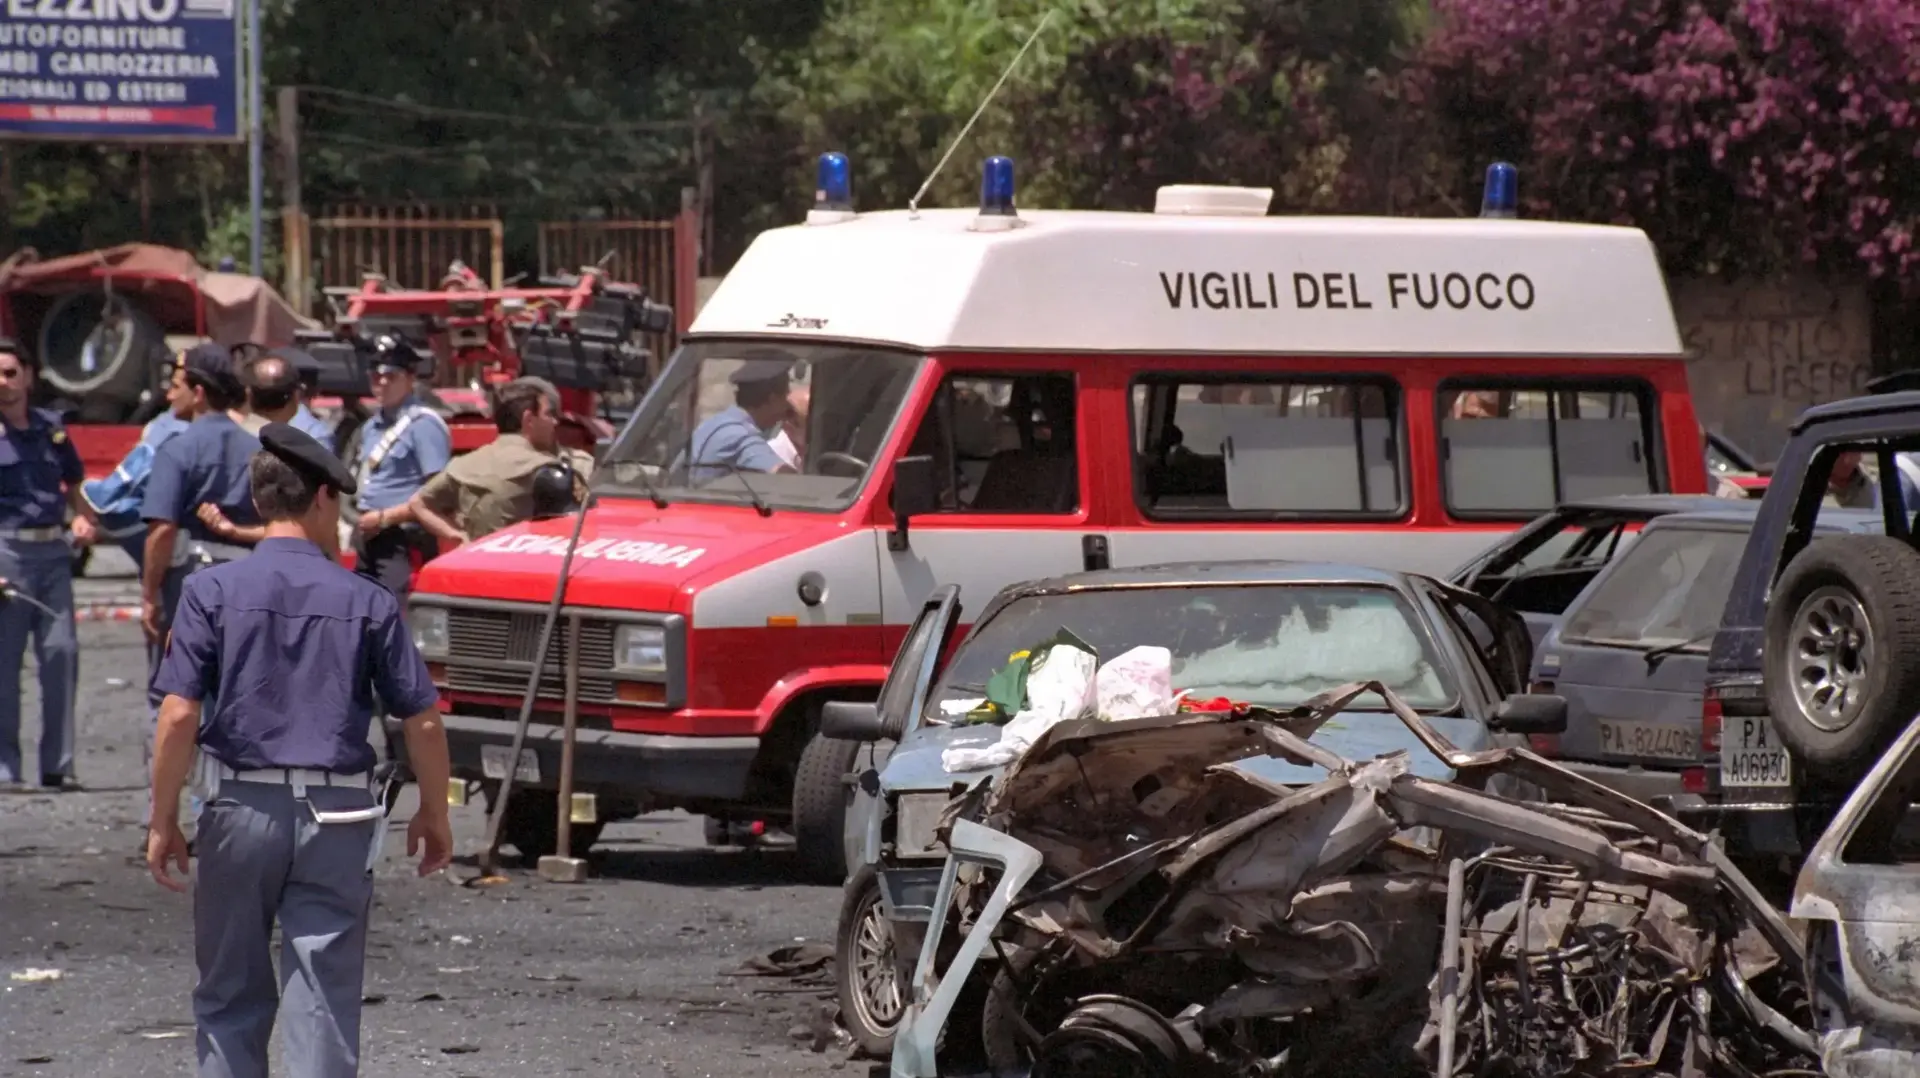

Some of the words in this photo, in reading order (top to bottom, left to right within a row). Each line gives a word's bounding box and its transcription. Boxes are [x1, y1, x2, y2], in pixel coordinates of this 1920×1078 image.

[0, 0, 180, 21] EZZINO
[50, 51, 219, 78] CARROZZERIA
[83, 80, 111, 101] ED
[1159, 271, 1279, 310] VIGILI
[1293, 271, 1373, 310] DEL
[1387, 271, 1535, 311] FUOCO
[1743, 719, 1768, 749] PA
